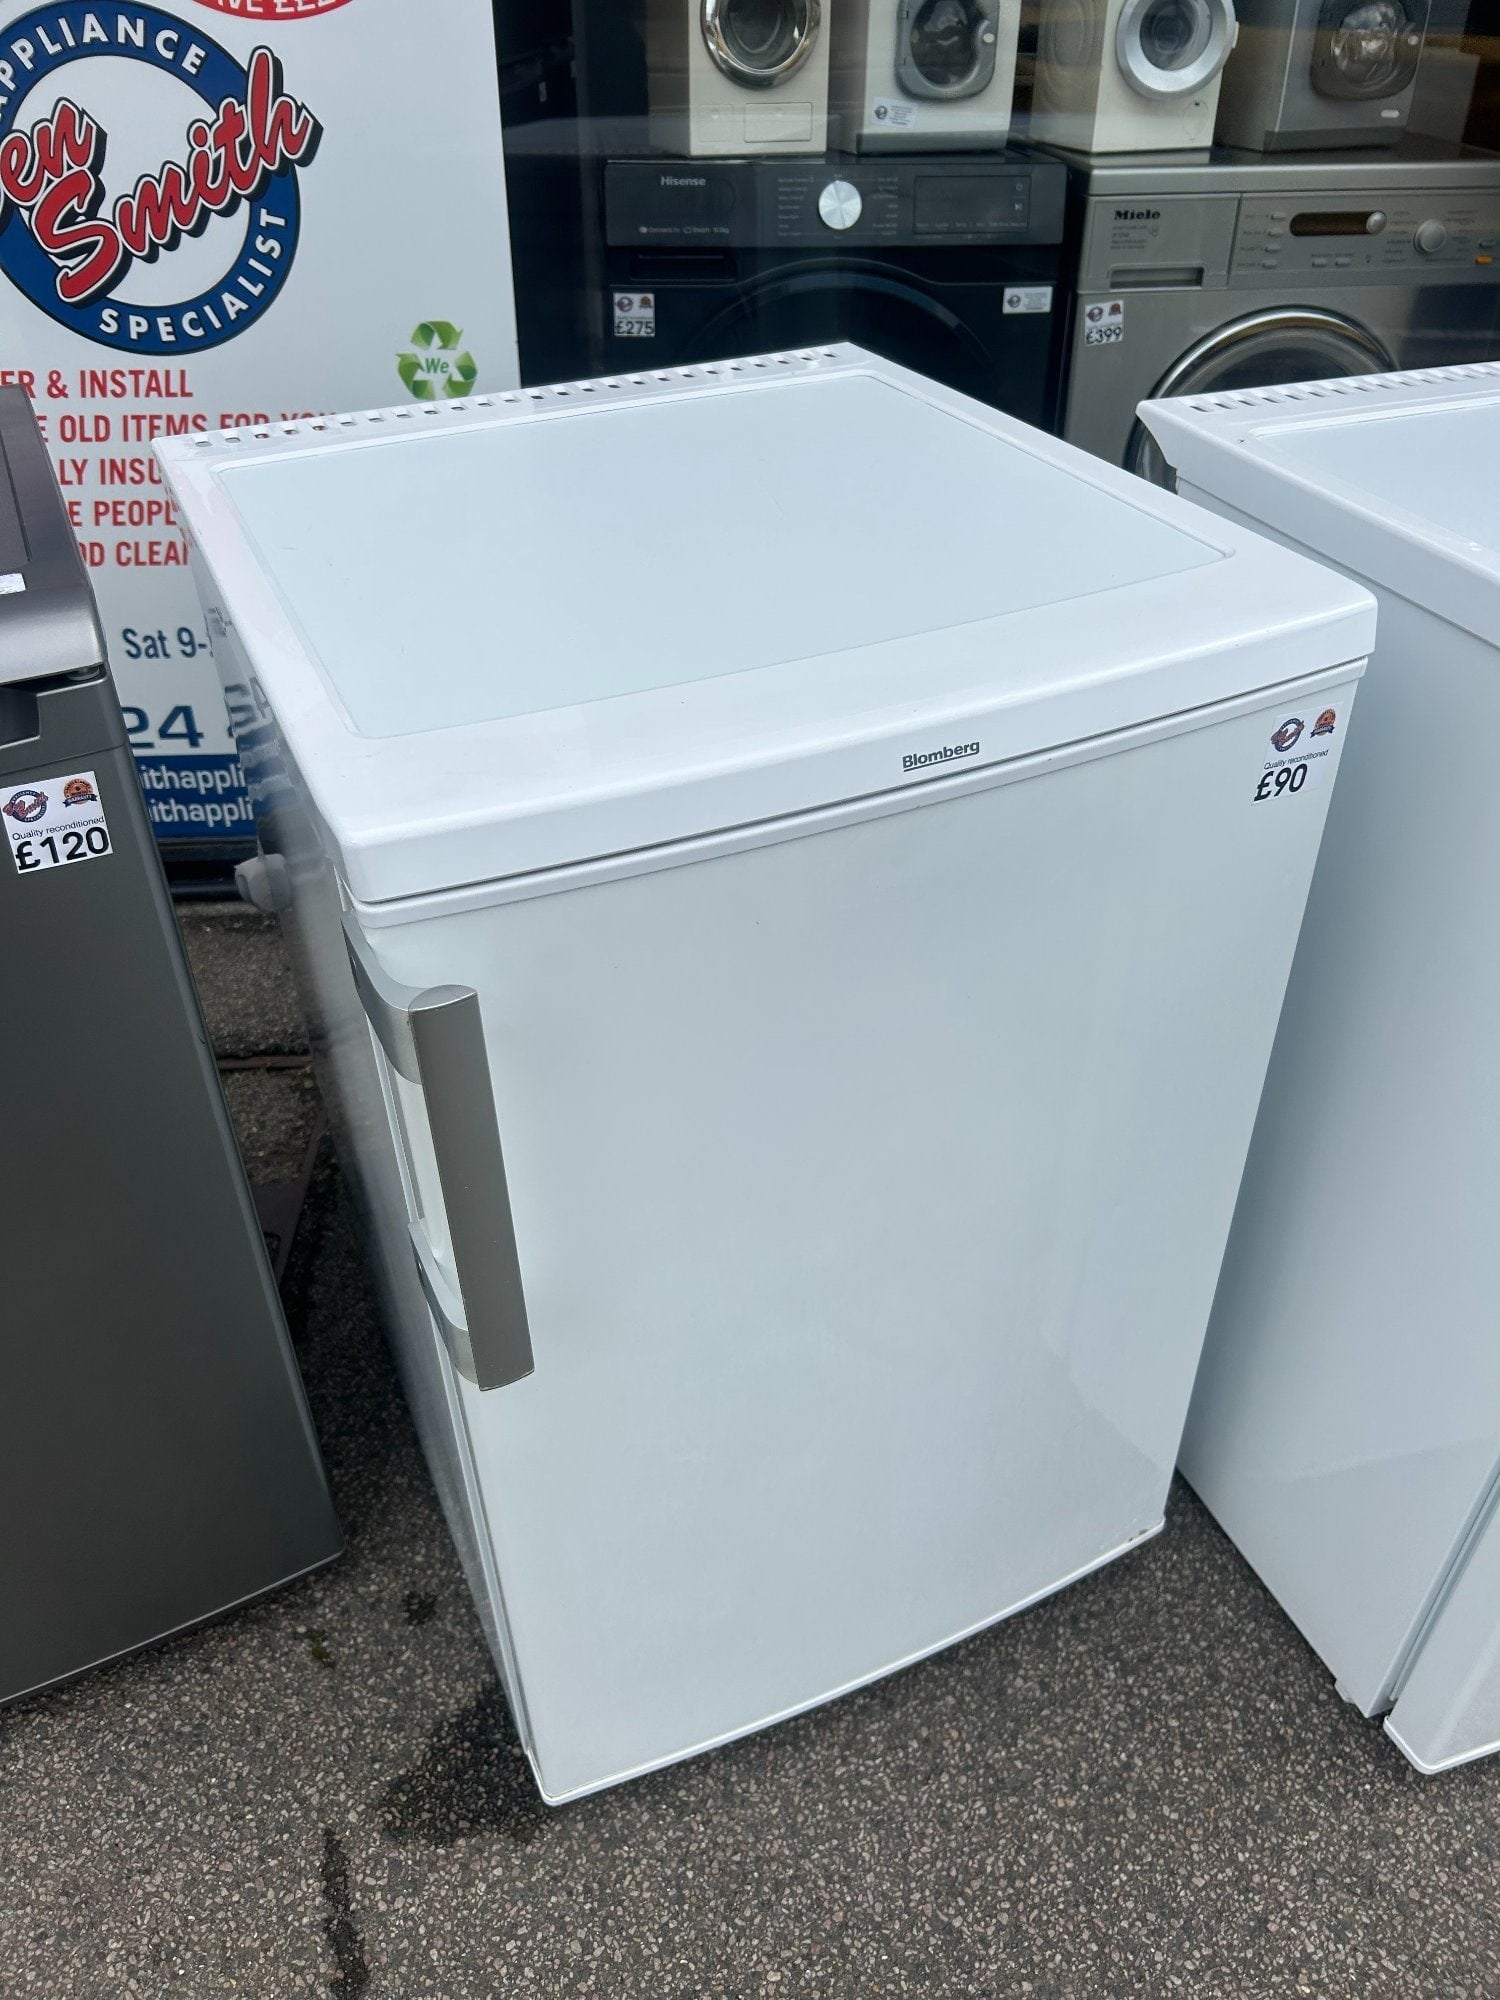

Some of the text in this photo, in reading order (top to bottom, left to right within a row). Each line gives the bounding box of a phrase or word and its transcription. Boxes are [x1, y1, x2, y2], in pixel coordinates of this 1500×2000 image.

[32, 45, 318, 306] Smith
[660, 176, 706, 187] Hisense
[1114, 209, 1161, 221] Miele
[99, 208, 286, 342] SPECIALIST
[615, 320, 655, 335] £275
[1087, 327, 1122, 345] £399
[425, 357, 450, 374] We
[46, 370, 69, 398] &
[80, 370, 193, 398] INSTALL
[60, 414, 110, 442] OLD
[123, 414, 208, 442] ITEMS
[59, 458, 163, 485] LY INSU
[95, 501, 177, 526] PEOPL
[116, 541, 188, 567] CLEA
[122, 628, 171, 659] Sat
[903, 741, 980, 772] Blomberg
[1263, 759, 1287, 770] Quality
[140, 763, 246, 795] ithappli
[1253, 763, 1308, 802] £90
[149, 797, 254, 828] ithappli
[12, 815, 105, 841] Quality reconditioned
[15, 826, 110, 871] £120
